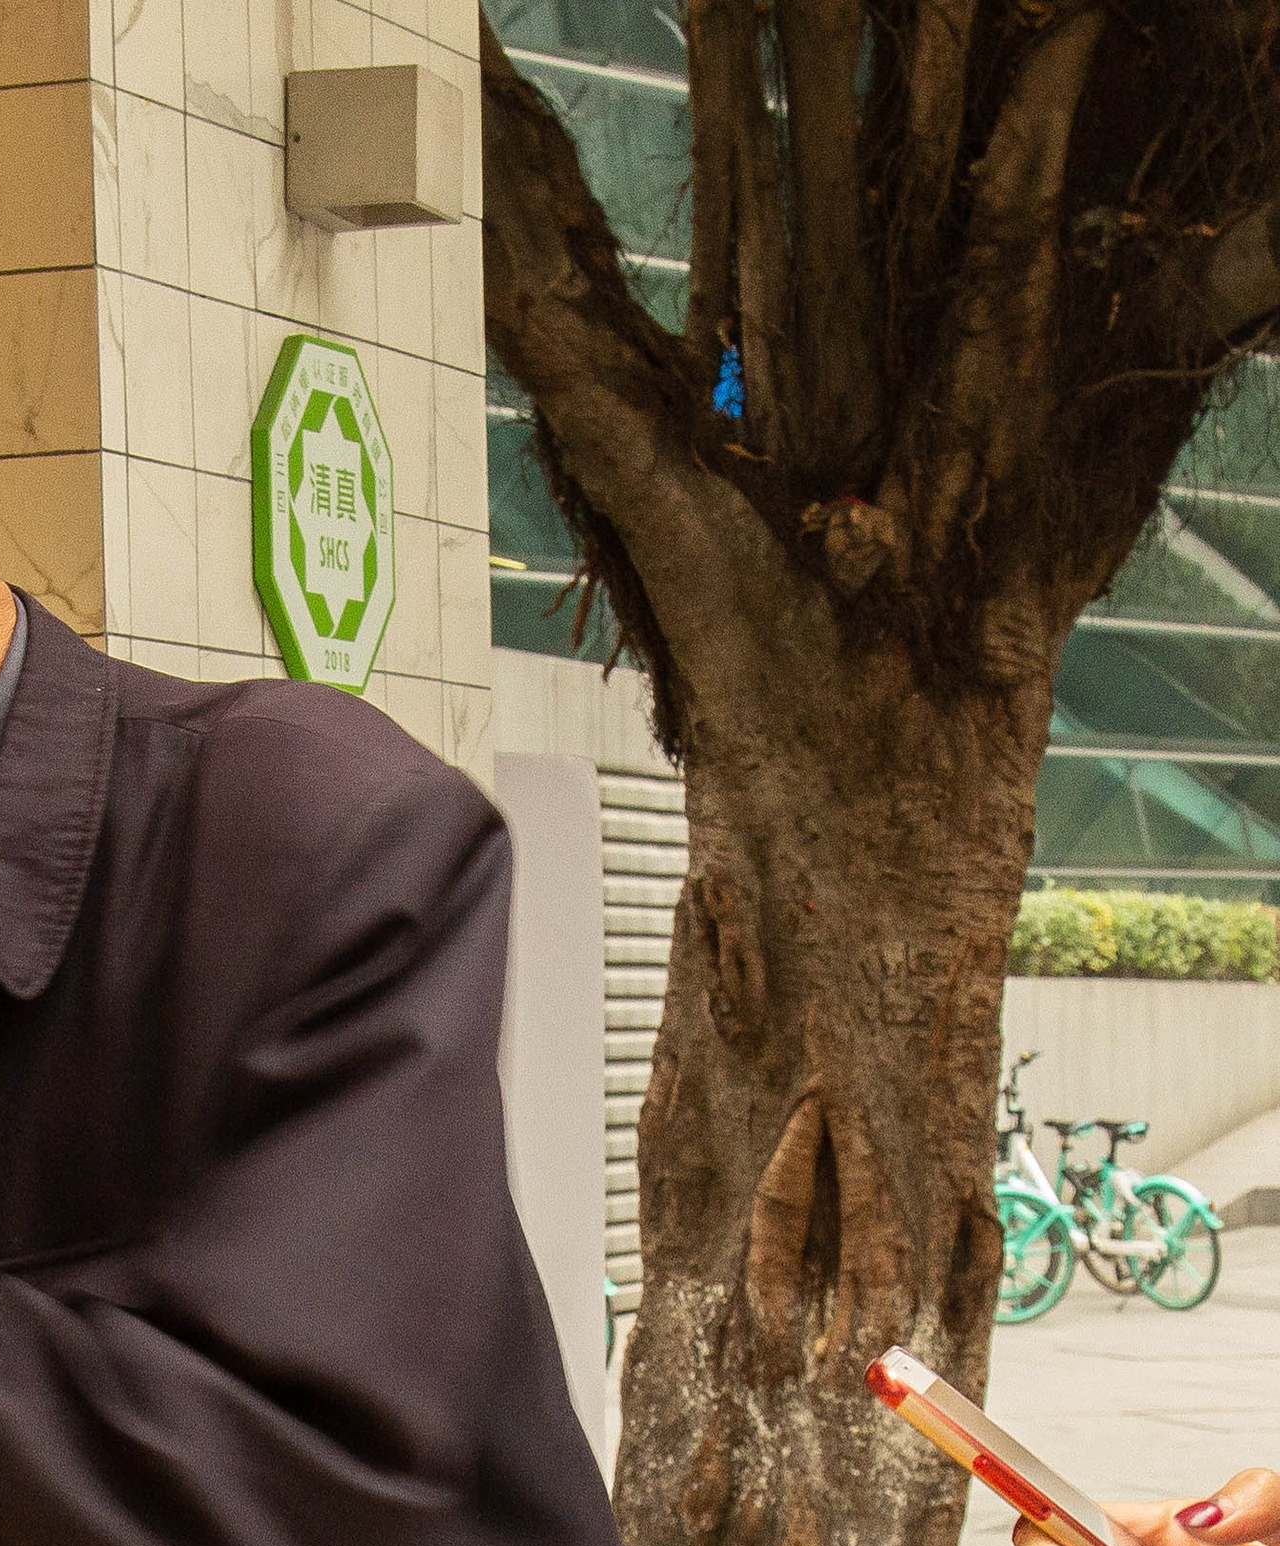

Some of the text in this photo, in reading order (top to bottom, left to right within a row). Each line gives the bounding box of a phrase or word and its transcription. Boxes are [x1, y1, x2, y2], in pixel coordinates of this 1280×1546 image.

[309, 461, 357, 524] 清真
[319, 534, 351, 573] SHCS
[323, 648, 351, 673] 2018
